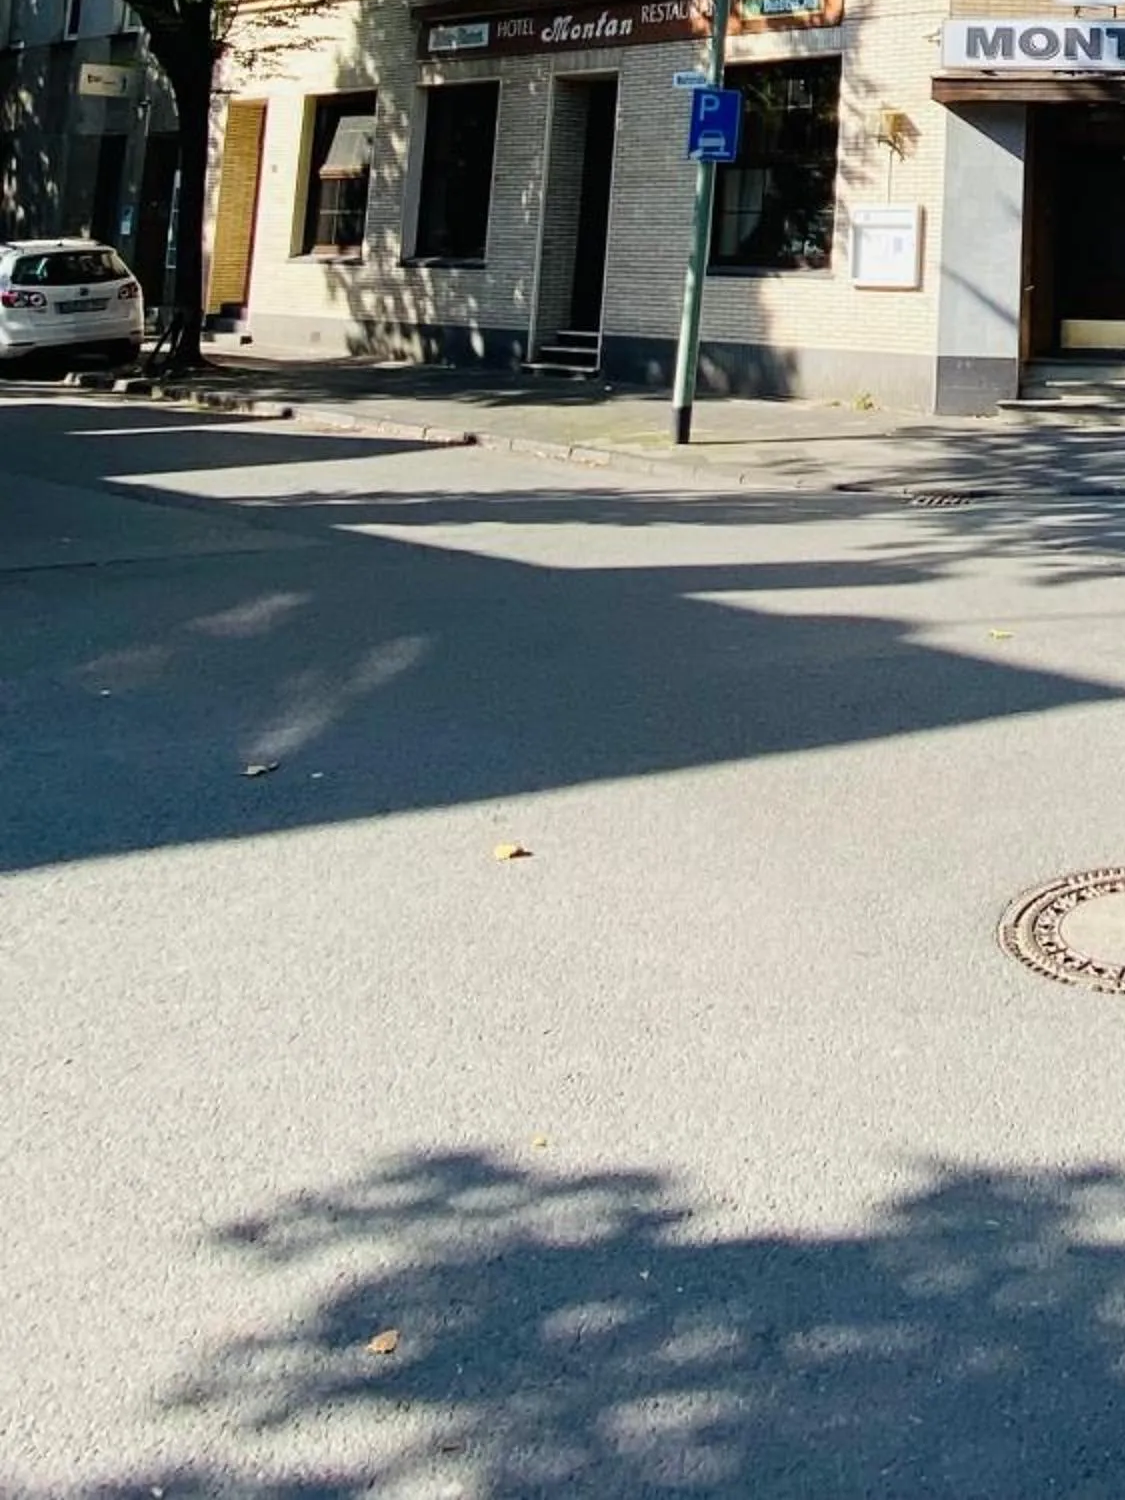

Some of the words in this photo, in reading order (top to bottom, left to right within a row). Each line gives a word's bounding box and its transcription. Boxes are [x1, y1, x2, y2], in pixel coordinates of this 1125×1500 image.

[497, 18, 536, 38] HOTEL
[541, 10, 633, 43] Montan
[700, 94, 720, 121] P
